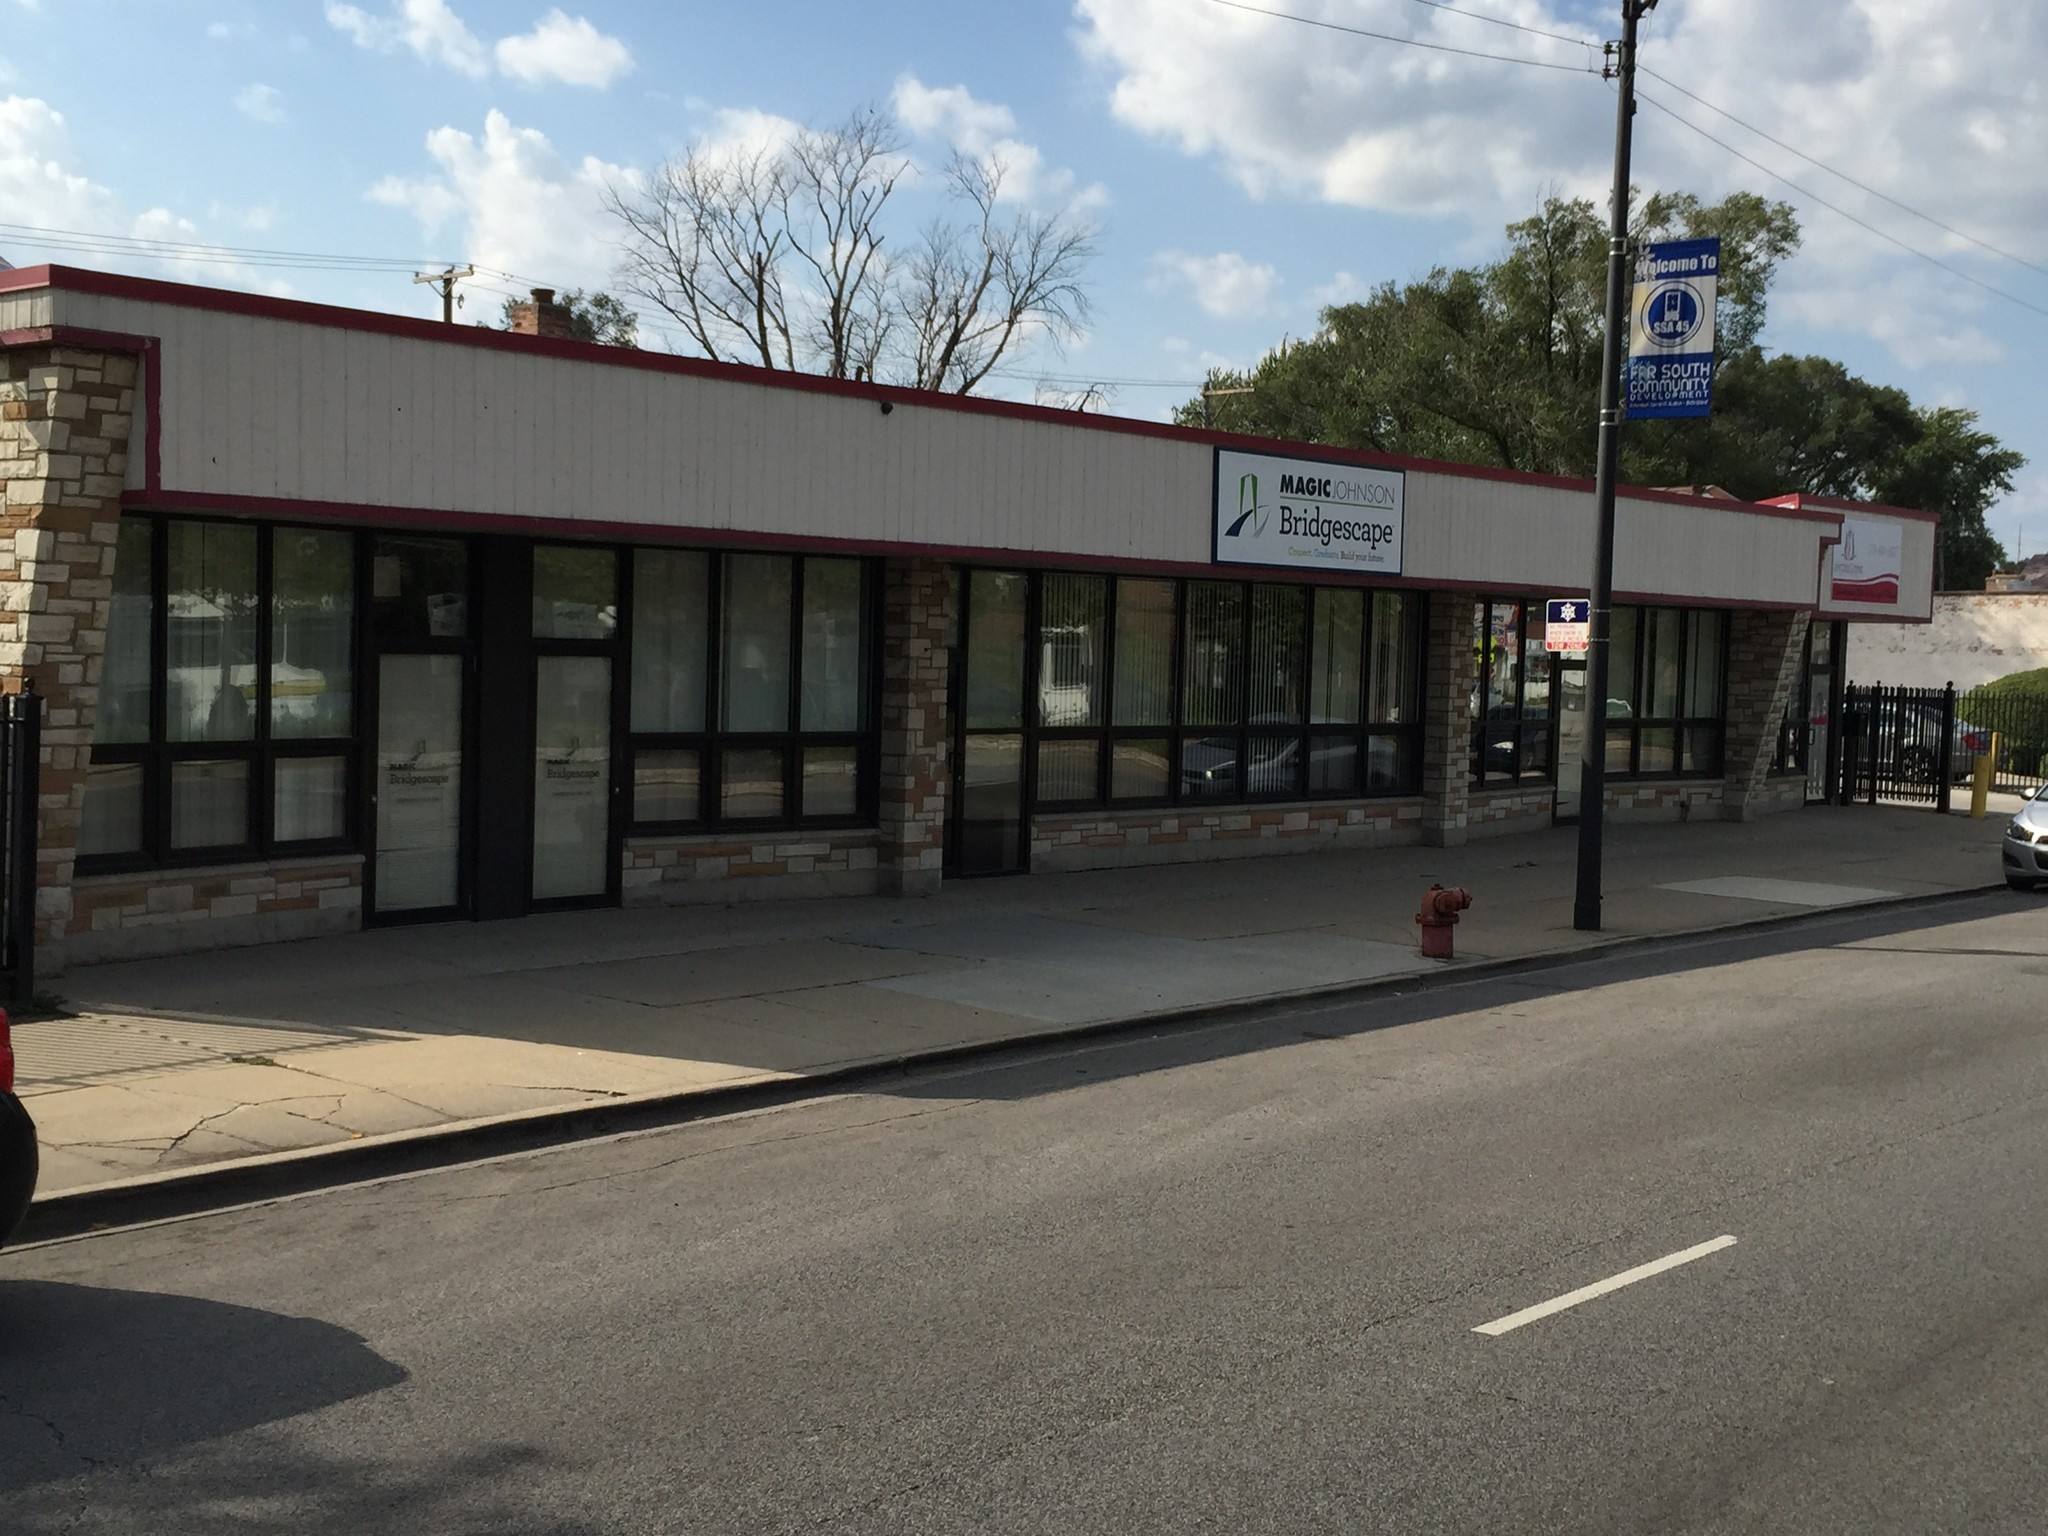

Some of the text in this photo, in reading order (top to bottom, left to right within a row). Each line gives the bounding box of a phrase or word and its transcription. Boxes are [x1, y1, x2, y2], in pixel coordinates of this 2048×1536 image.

[1635, 254, 1717, 275] Welcome To
[1653, 320, 1689, 334] SSA 45
[1630, 362, 1711, 380] FAR SOUTH
[1279, 506, 1393, 550] Bridgescape
